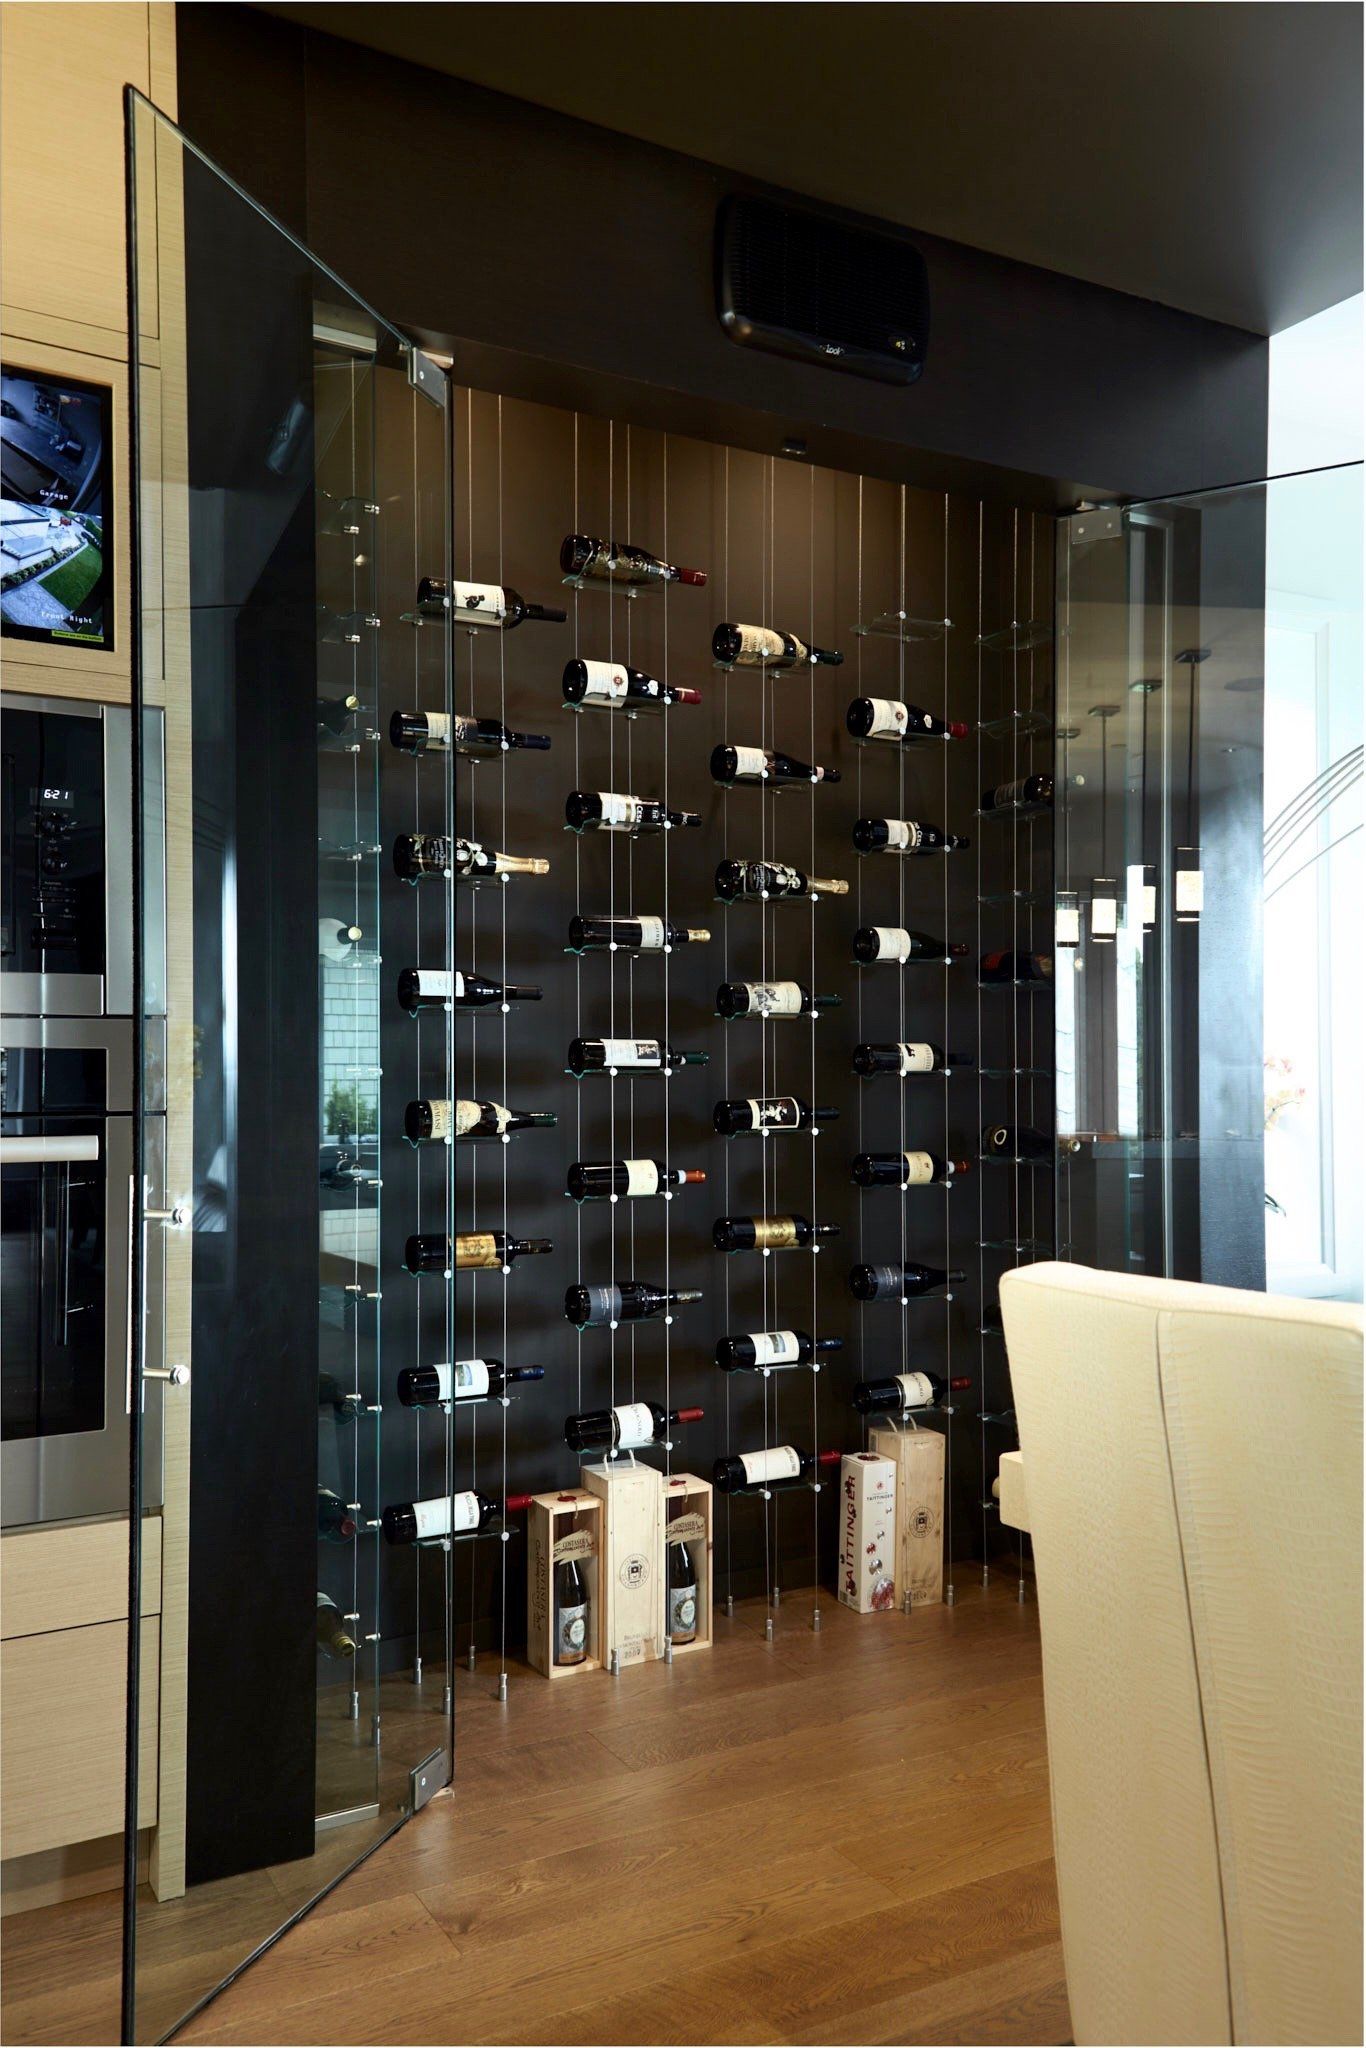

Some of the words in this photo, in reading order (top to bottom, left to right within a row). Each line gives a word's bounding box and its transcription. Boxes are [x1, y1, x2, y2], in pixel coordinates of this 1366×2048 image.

[39, 488, 69, 500] Garage
[41, 611, 65, 620] Front
[69, 615, 93, 624] Right
[44, 788, 69, 800] 6:21
[845, 1475, 856, 1593] TAITTINGER
